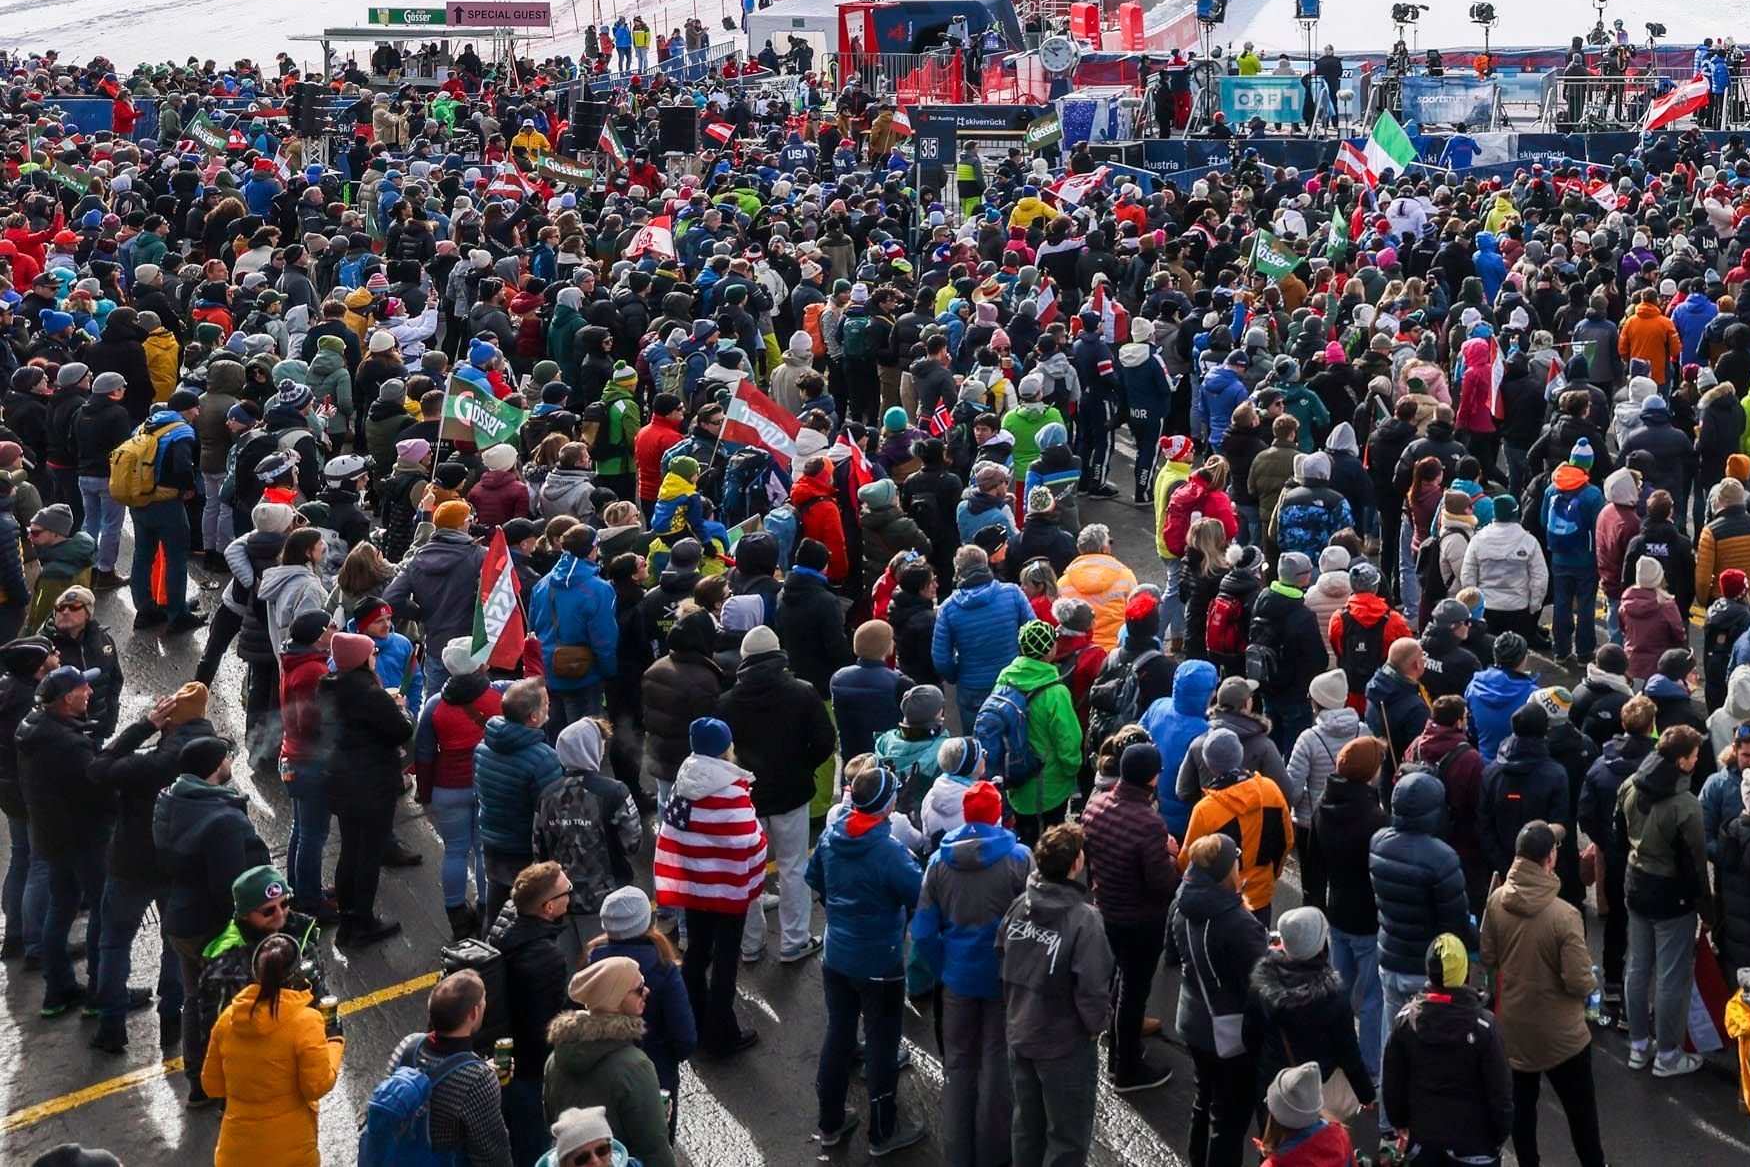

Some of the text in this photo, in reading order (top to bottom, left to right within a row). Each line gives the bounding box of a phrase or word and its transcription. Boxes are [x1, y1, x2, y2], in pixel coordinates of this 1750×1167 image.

[403, 8, 432, 24] Gösser
[468, 10, 547, 21] SPECIAL GUEST
[957, 116, 1006, 127] #skiverrückt
[1030, 119, 1059, 141] Gösser
[191, 120, 220, 147] Gösser
[788, 149, 808, 160] USA
[921, 138, 938, 158] 35
[545, 158, 586, 178] Gösser
[1703, 236, 1719, 248] USA
[454, 391, 507, 437] Gösser
[1130, 408, 1148, 419] NOR
[1140, 468, 1149, 486] NOR
